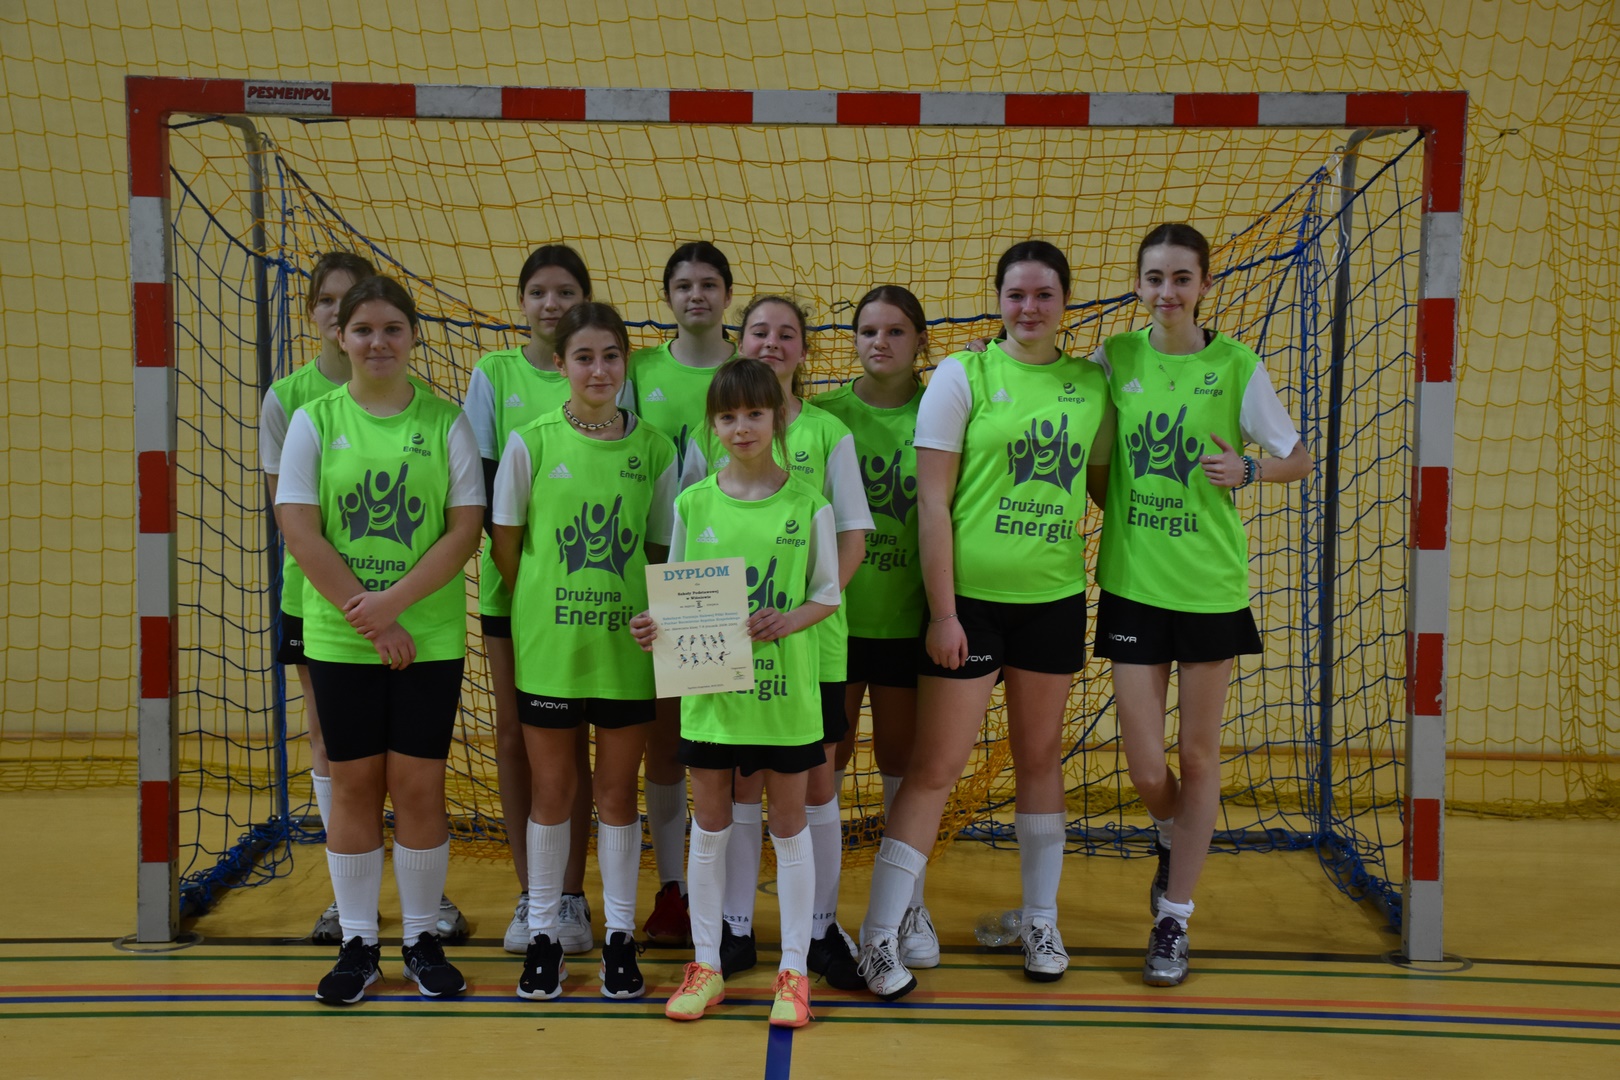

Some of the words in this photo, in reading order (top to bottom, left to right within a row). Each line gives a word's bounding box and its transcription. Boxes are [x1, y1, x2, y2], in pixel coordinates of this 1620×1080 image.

[247, 86, 331, 101] PESMENPOL
[1057, 395, 1085, 404] Energa
[1194, 387, 1223, 397] Energa
[403, 445, 432, 457] Energa
[620, 470, 647, 482] Energa
[785, 463, 814, 474] Energa
[999, 497, 1064, 517] Drużyna
[1130, 489, 1183, 512] Drużyna
[994, 514, 1073, 543] Energii
[1127, 507, 1199, 537] Energii
[776, 537, 806, 547] Energa
[862, 548, 908, 571] rgii
[663, 566, 730, 581] DYPLOM
[556, 587, 622, 605] Drużyna
[555, 606, 633, 632] Energii
[724, 914, 749, 922] PSTA
